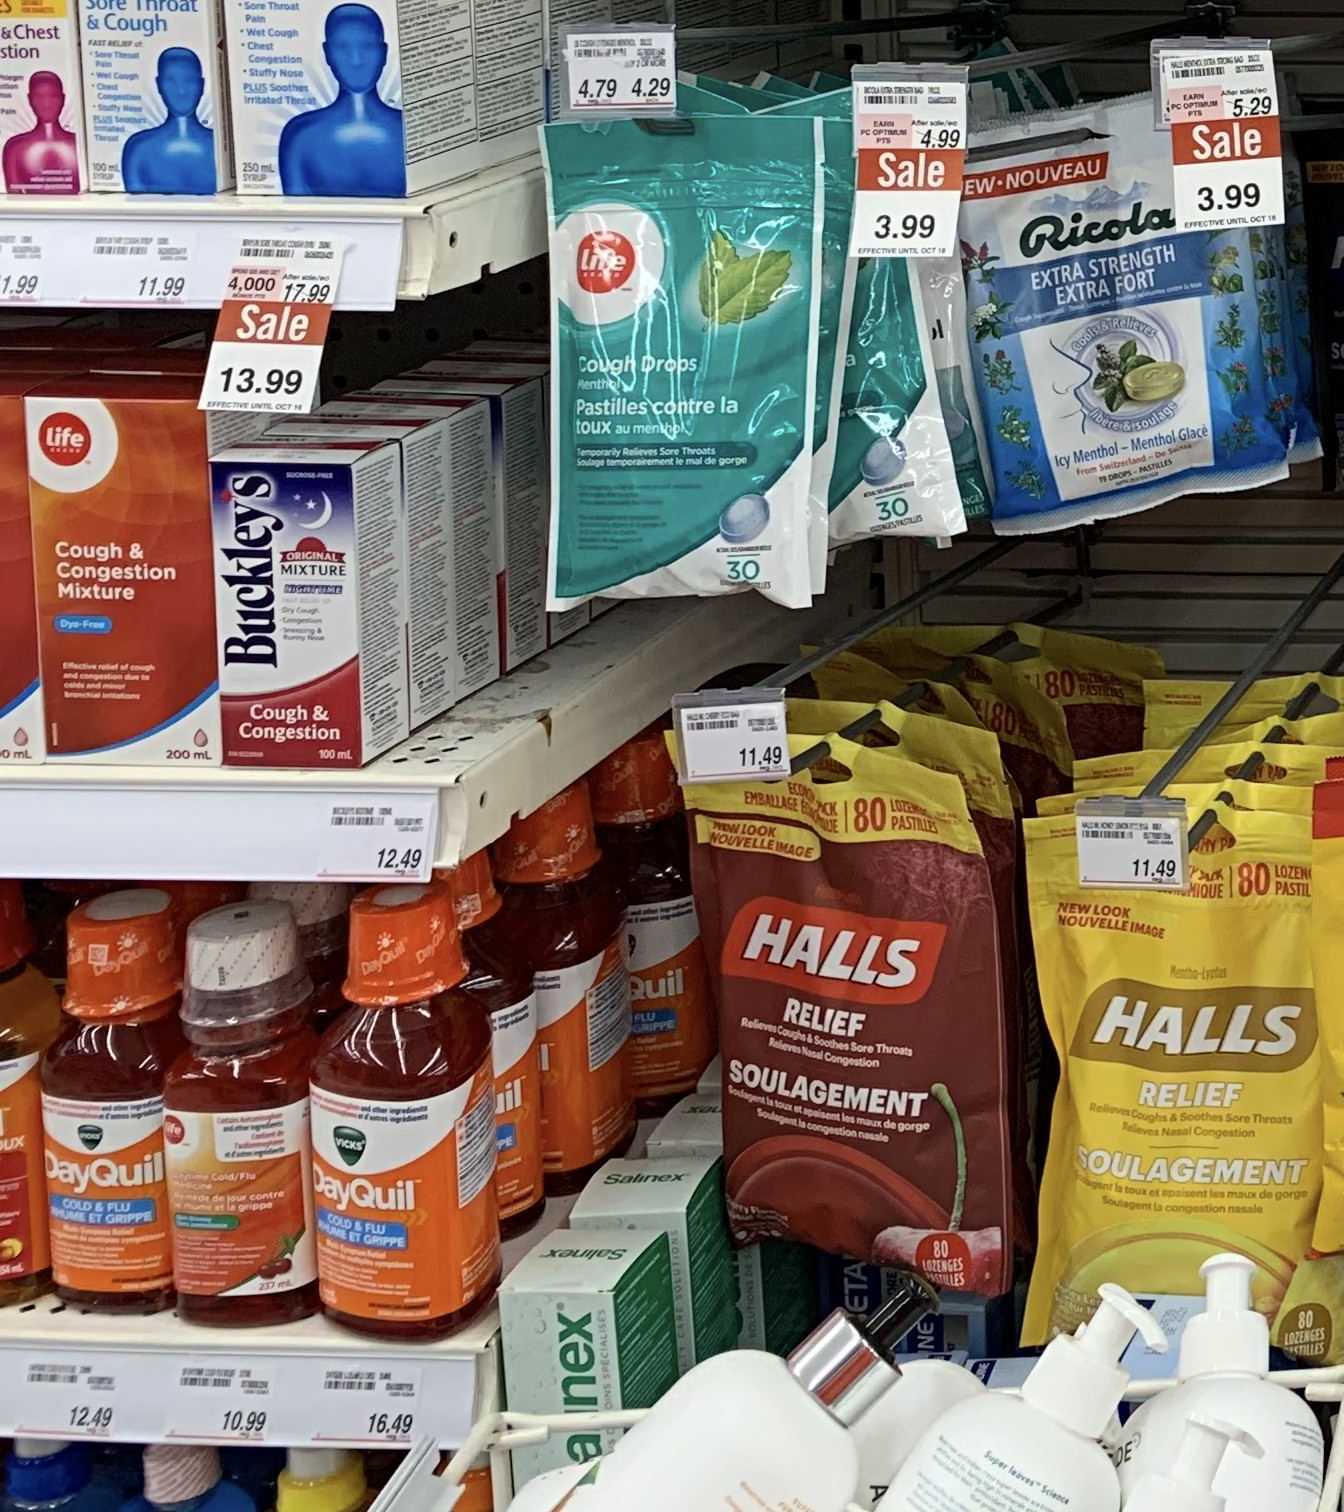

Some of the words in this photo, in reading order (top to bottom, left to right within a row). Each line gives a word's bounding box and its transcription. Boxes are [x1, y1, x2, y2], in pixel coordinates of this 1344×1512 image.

[1031, 265, 1084, 291] EXTRA
[1089, 244, 1176, 279] STRENGTH
[138, 276, 185, 296] 11.99
[45, 427, 85, 449] life
[55, 541, 123, 563] Cough
[129, 543, 143, 560] &
[286, 552, 339, 562] ORIGINAL
[57, 562, 176, 582] Congestion
[220, 474, 284, 669] Buckley's
[280, 564, 347, 576] MIXTURE
[58, 582, 135, 601] Mixture
[739, 747, 783, 767] 11.49
[377, 849, 422, 869] 12.49
[743, 913, 920, 988] HALLS
[729, 1060, 928, 1118] SOULAGEMENT
[335, 1137, 362, 1151] VICKS
[604, 1172, 685, 1186] Salinex
